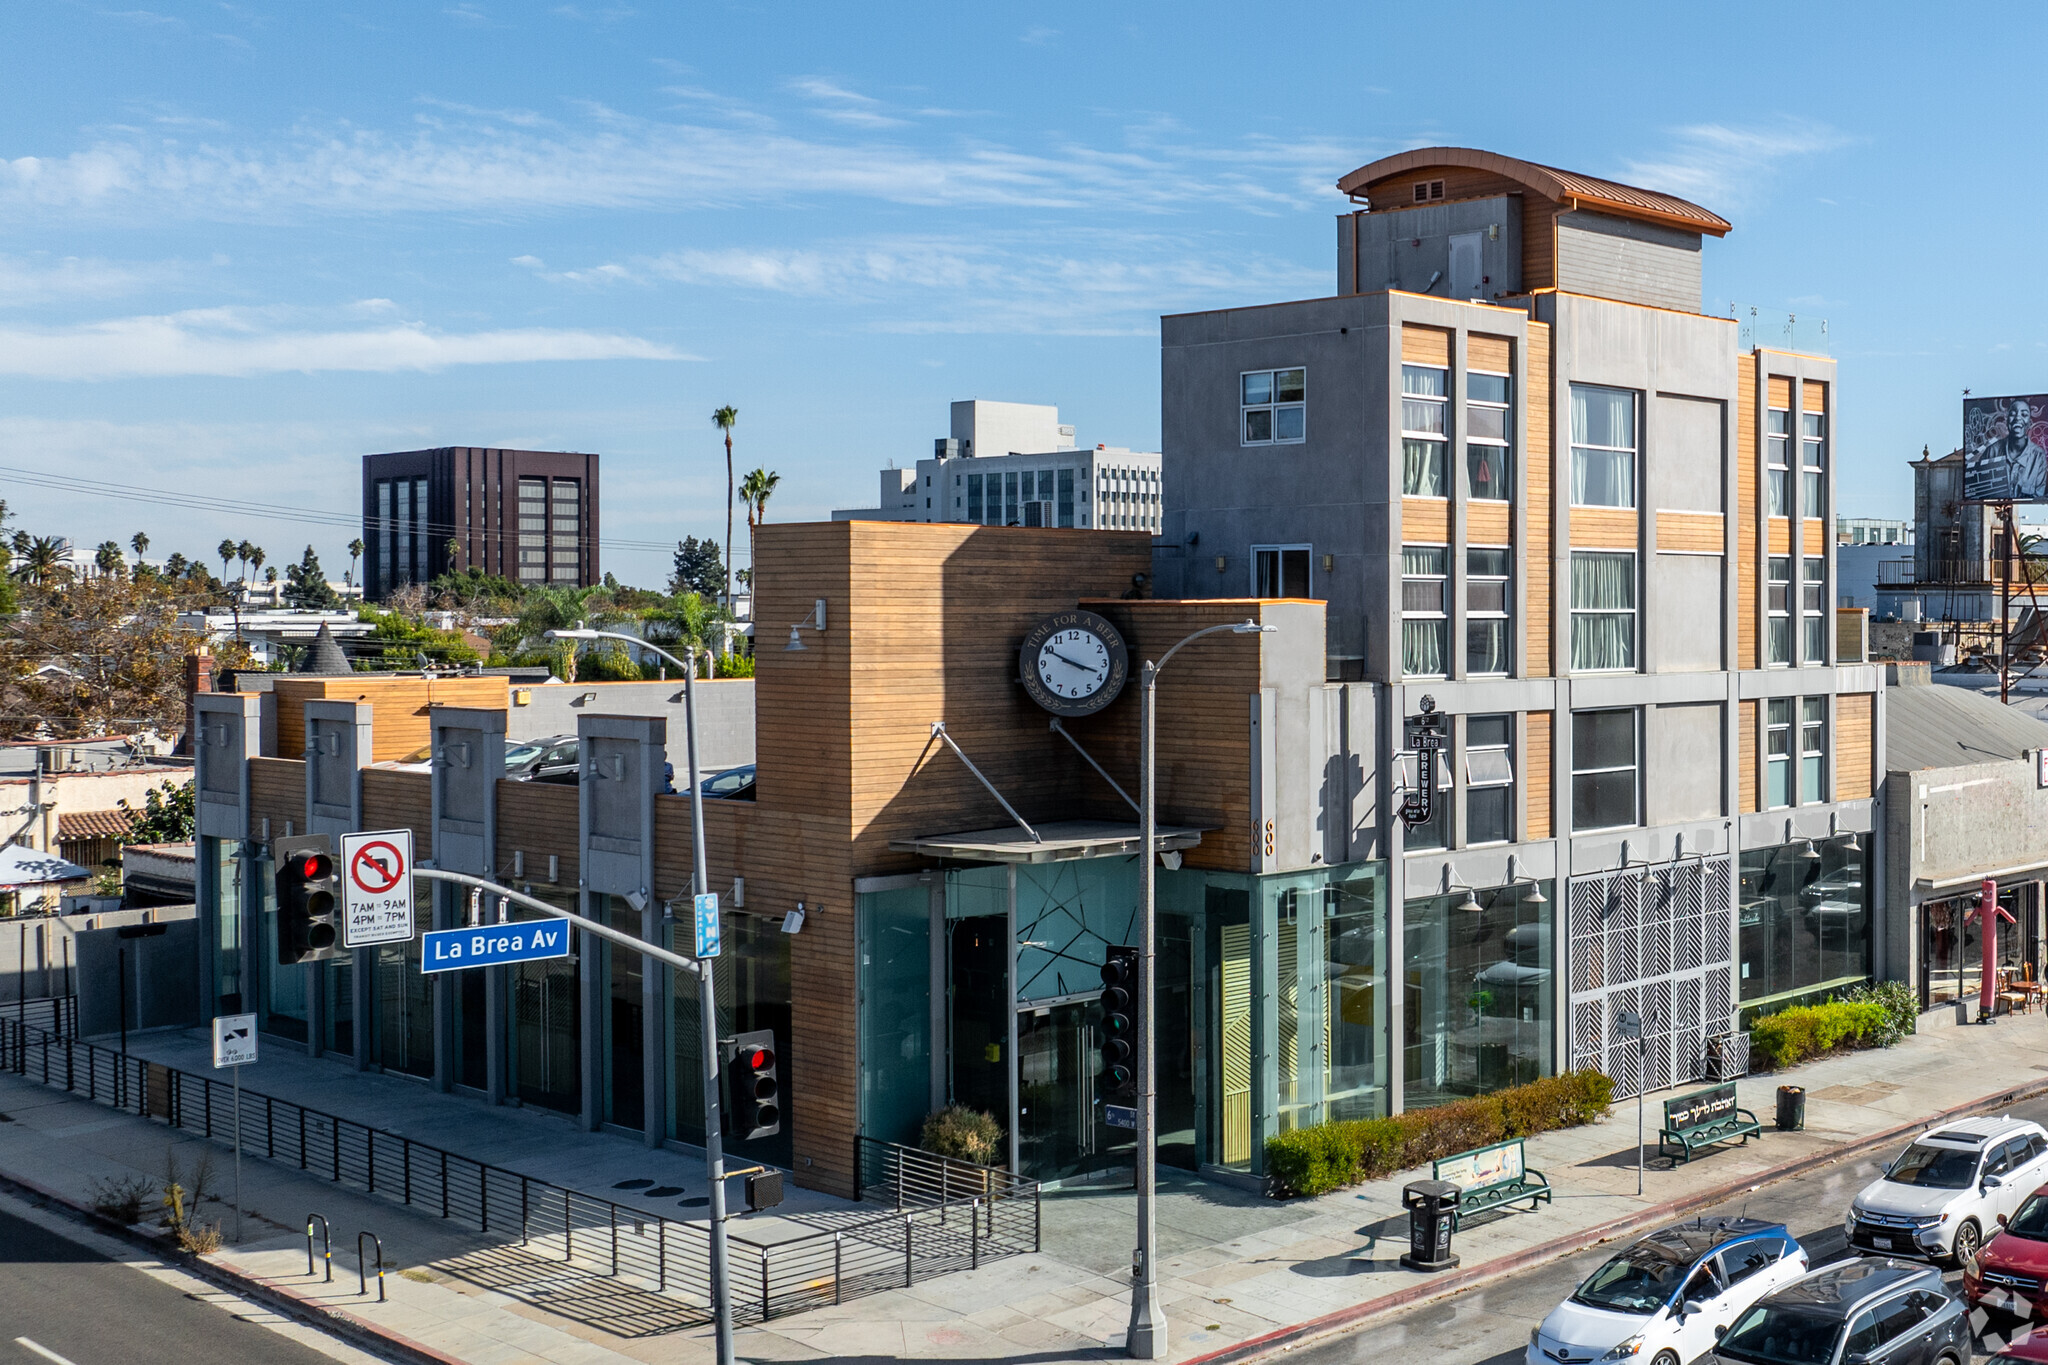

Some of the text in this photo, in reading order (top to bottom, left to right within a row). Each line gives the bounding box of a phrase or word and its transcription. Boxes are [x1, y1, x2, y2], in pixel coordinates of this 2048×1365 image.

[1027, 614, 1120, 649] TIME FOR A BEER
[1068, 631, 1080, 641] 12
[1054, 636, 1063, 644] 11
[1086, 635, 1091, 644] 1
[1044, 645, 1054, 654] 10
[1096, 645, 1103, 654] 2
[1040, 660, 1046, 669] 9
[1101, 659, 1108, 668] 3
[1046, 674, 1052, 683] 8
[1096, 673, 1103, 682] 4
[1057, 684, 1063, 693] 7
[1071, 688, 1078, 696] 6
[1086, 684, 1092, 693] 5
[1412, 736, 1438, 748] La Brea
[1420, 752, 1428, 816] BREWERY
[1266, 818, 1274, 856] 600
[351, 902, 374, 913] 7AM
[384, 899, 406, 910] 9AM
[352, 915, 374, 925] 4PM
[384, 912, 406, 922] 7PM
[704, 898, 717, 952] SYNC
[434, 930, 558, 961] La Brea Av
